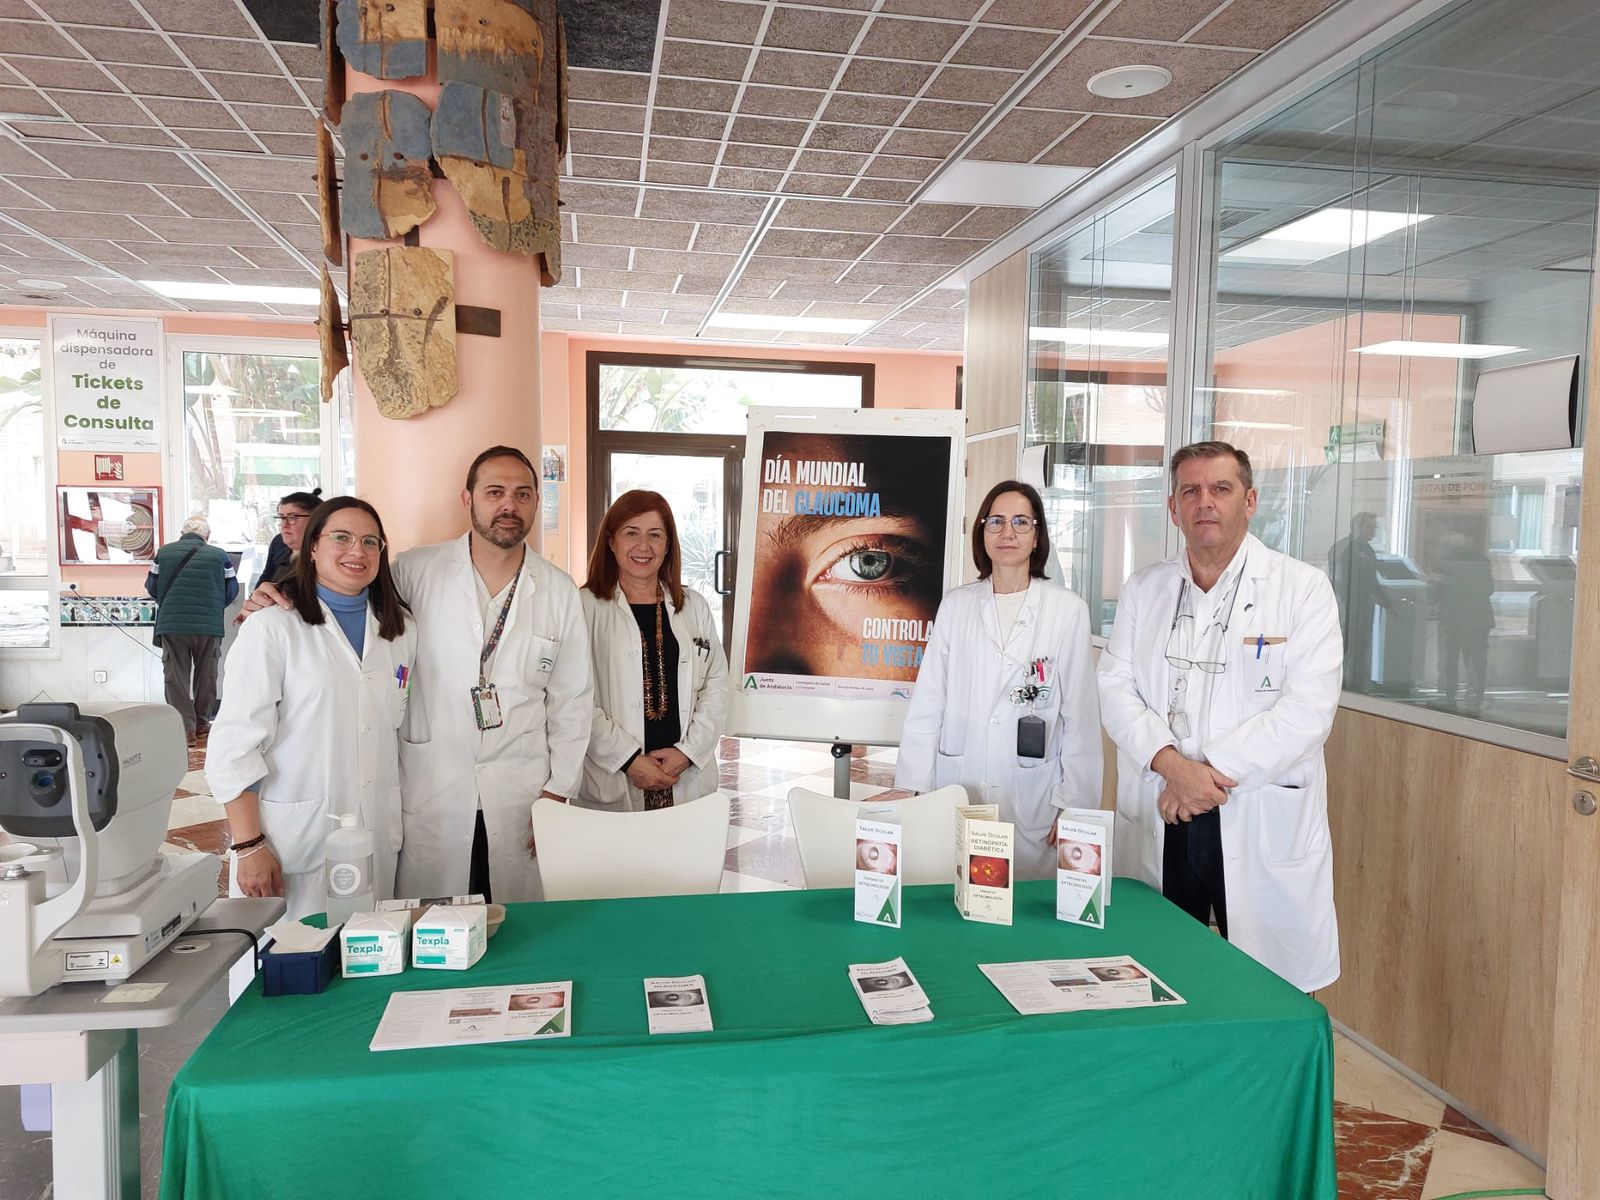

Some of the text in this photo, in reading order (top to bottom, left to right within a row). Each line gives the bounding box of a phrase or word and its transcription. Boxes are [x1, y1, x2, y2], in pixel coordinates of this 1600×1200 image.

[77, 328, 137, 342] Máquina
[60, 343, 153, 356] dispensadora
[99, 360, 116, 369] de
[72, 373, 144, 391] Tickets
[96, 395, 121, 409] de
[64, 414, 154, 430] Consulta
[764, 454, 867, 487] DÍA MUNDIAL
[762, 488, 881, 518] DEL GLAUCOMA
[862, 617, 934, 642] CONTROLA
[863, 642, 924, 668] TU VISTA
[416, 936, 450, 947] Texpla
[346, 944, 383, 955] Texpla
